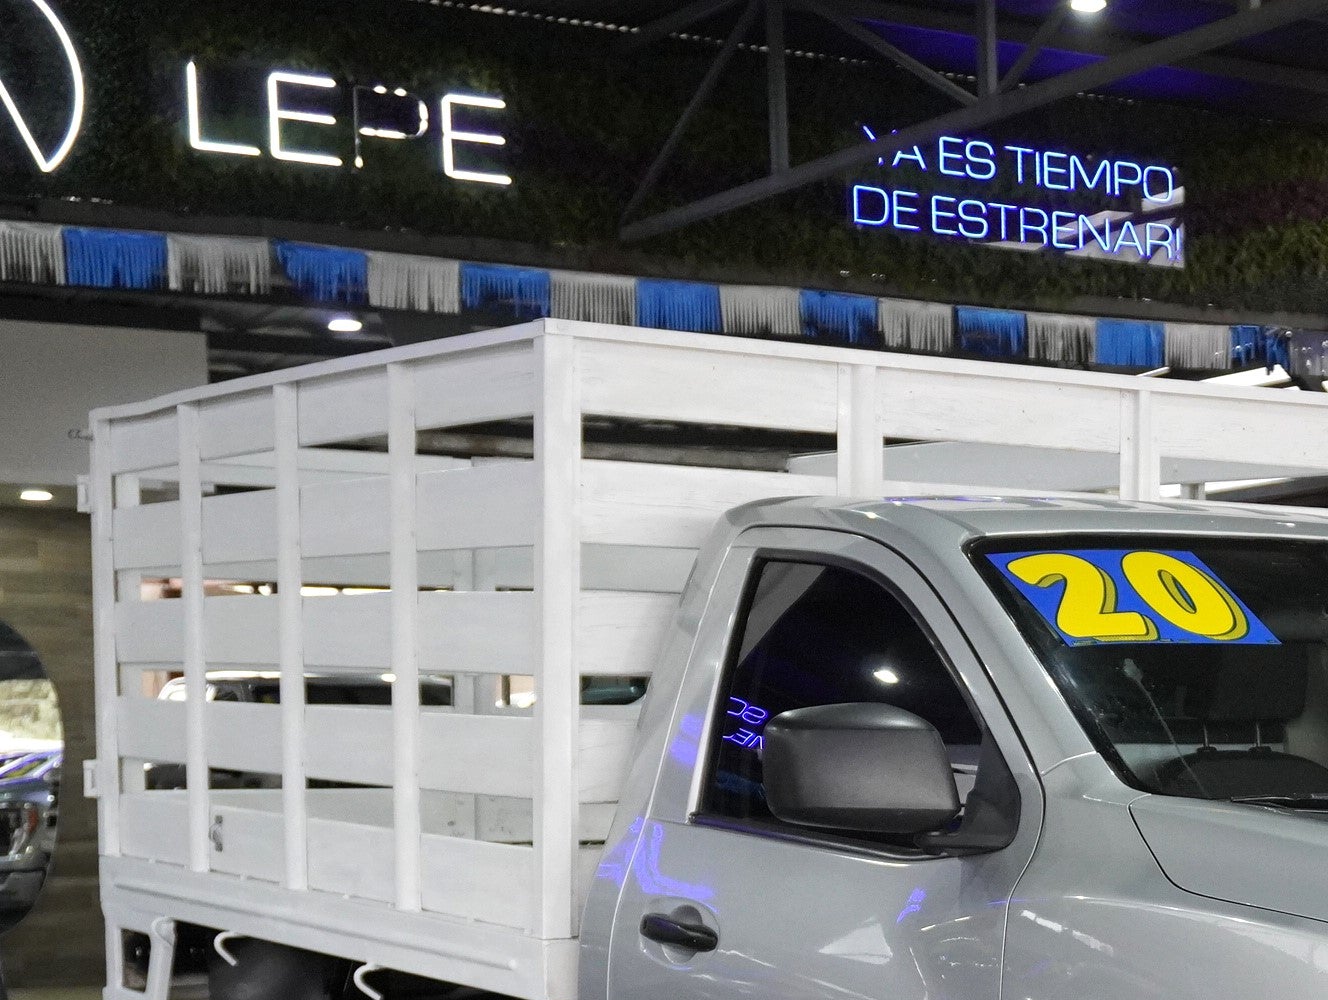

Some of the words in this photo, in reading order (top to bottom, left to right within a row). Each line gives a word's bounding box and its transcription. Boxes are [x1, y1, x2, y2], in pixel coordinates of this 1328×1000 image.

[186, 61, 512, 186] LEPE
[852, 184, 922, 232] DE
[938, 135, 996, 180] ES
[1004, 144, 1174, 204] TIEMPO
[1005, 550, 1250, 642] 20
